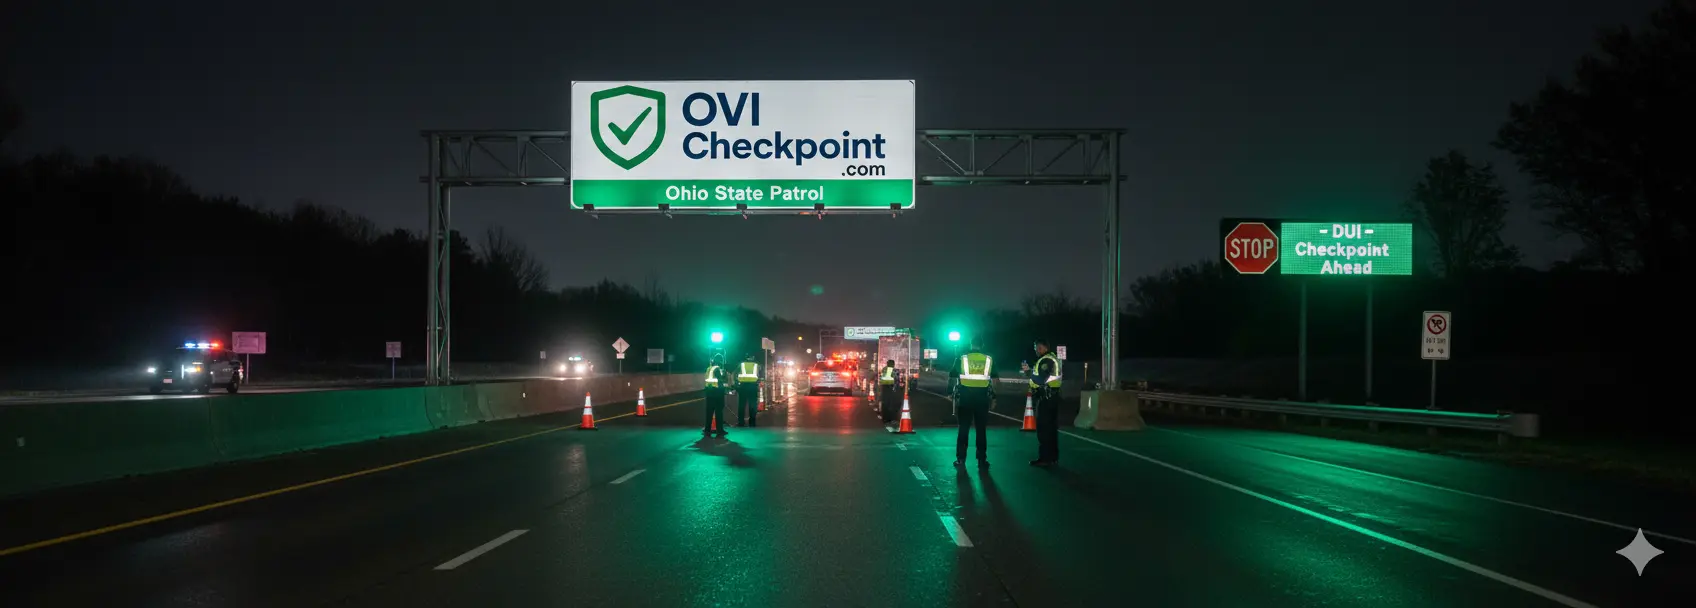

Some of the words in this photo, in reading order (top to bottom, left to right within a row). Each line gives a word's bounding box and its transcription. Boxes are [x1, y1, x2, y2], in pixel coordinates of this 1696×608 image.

[682, 92, 760, 126] OVI
[682, 130, 886, 165] Checkpoint
[841, 164, 886, 177] .com
[665, 185, 709, 201] Ohio
[715, 185, 763, 201] State
[770, 185, 824, 201] Patrol
[1229, 238, 1274, 259] STOP
[1295, 242, 1389, 260] Checkpoint
[1321, 260, 1372, 274] Ahead
